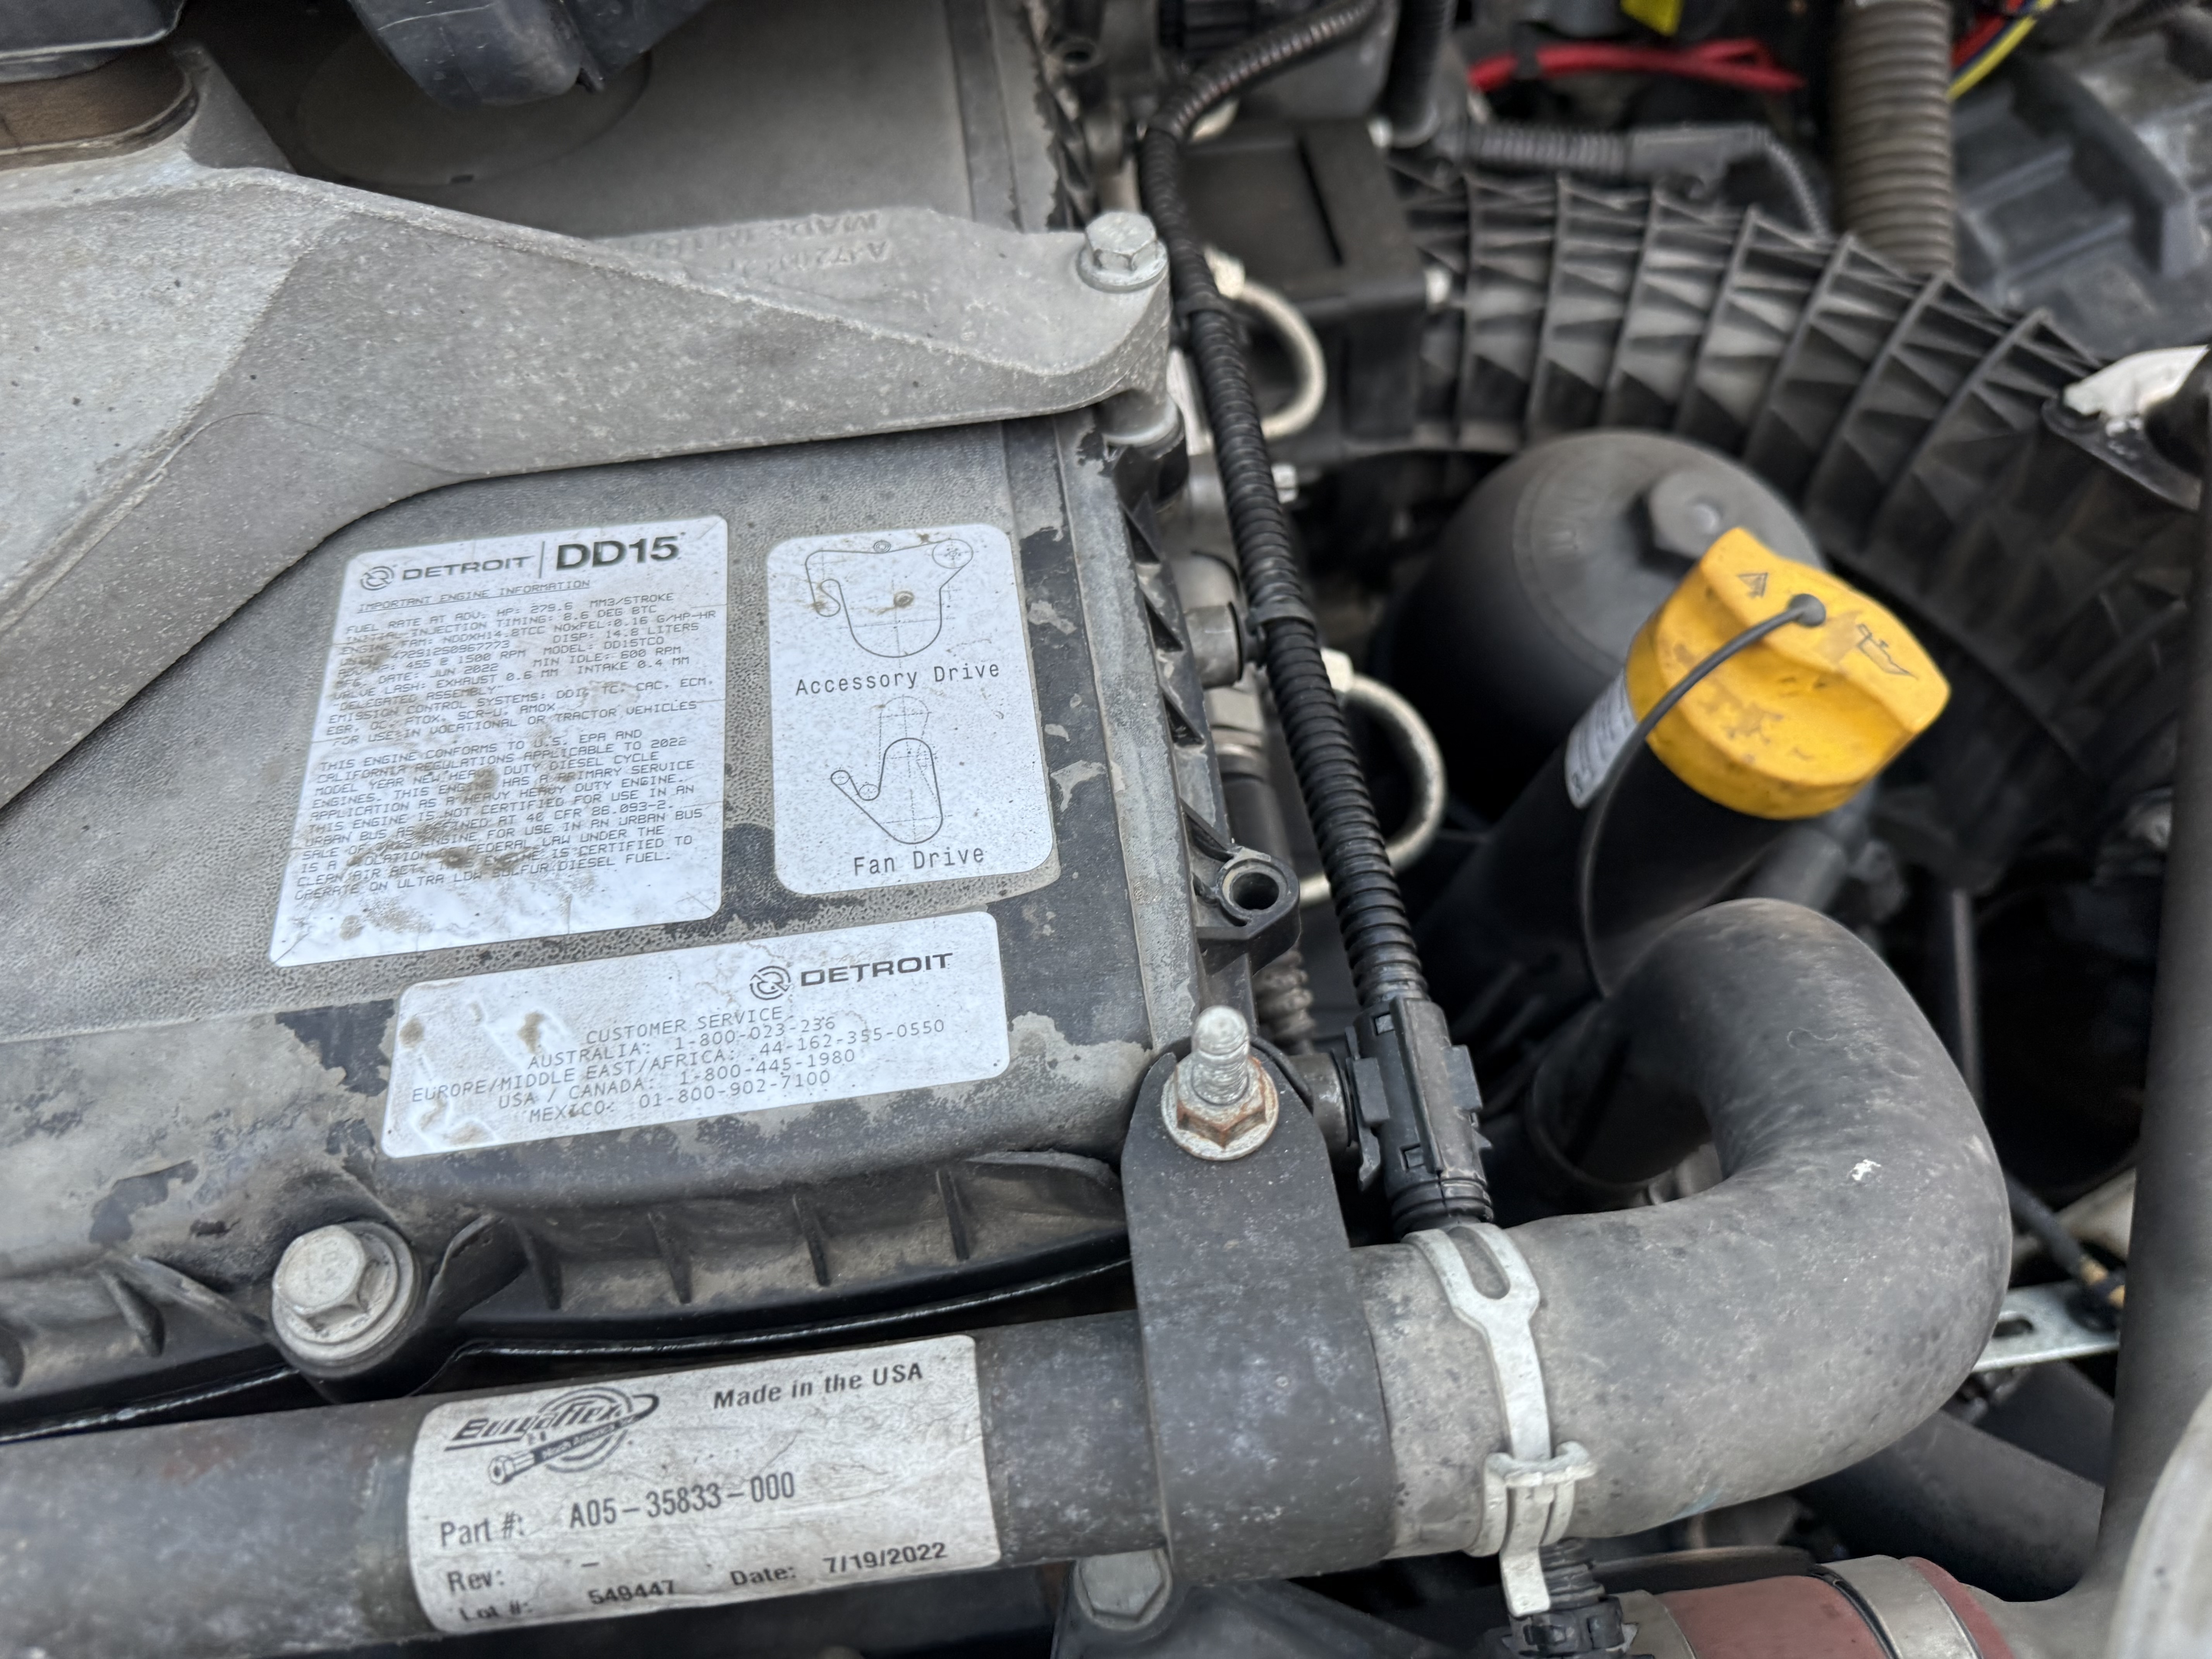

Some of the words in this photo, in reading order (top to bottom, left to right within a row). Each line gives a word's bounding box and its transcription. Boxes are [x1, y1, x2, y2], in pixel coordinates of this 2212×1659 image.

[402, 555, 535, 580] DETROIT
[556, 536, 679, 571] DD15
[345, 623, 380, 634] FUEL
[388, 618, 421, 629] RATE
[430, 615, 446, 624] AT
[589, 592, 674, 607] MM3/STROKE
[359, 596, 431, 611] IMPORTANT
[440, 590, 489, 602] ENGINE
[499, 579, 590, 596] INFORMATION
[497, 615, 553, 627] TIMING:
[563, 611, 589, 620] 8.6
[598, 608, 623, 617] DEG
[632, 605, 657, 614] BTC
[553, 632, 594, 643] DISP:
[606, 628, 639, 638] 14.8
[647, 622, 699, 634] LITERS
[384, 682, 426, 694] LASH:
[436, 675, 497, 688] EXHAUST
[506, 671, 532, 681] 0.6
[541, 668, 558, 677] MM
[578, 661, 628, 673] INTAKE
[637, 658, 663, 668] 0.4
[672, 656, 689, 665] MM
[405, 659, 431, 669] 455
[458, 653, 491, 663] 1500
[500, 649, 526, 659] RPM
[543, 642, 593, 654] MODEL:
[430, 668, 456, 678] JUN
[464, 663, 498, 674] 2022
[532, 657, 559, 667] MIN
[621, 649, 646, 658] 600
[656, 646, 681, 655] RPM
[795, 672, 917, 696] Accessory
[934, 663, 1000, 682] Drive
[404, 728, 421, 738] IN
[430, 718, 518, 735] VOCATIONAL
[527, 715, 545, 724] OR
[555, 708, 617, 721] TRACTOR
[626, 701, 697, 714] VEHICLES
[407, 700, 468, 714] CONTROL
[477, 692, 545, 706] SYSTEMS:
[520, 702, 555, 714] AMOX
[319, 759, 356, 771] THIS
[364, 752, 417, 766] ENGINE
[425, 744, 497, 759] CONFORMS
[507, 740, 525, 750] TO
[580, 732, 606, 742] EPA
[615, 728, 642, 739] AND
[415, 754, 514, 772] REGULATIONS
[524, 744, 614, 760] APPLICABLE
[624, 741, 641, 750] TO
[651, 737, 686, 748] 2022
[312, 792, 382, 808] ENGINES.
[393, 787, 429, 799] THIS
[502, 776, 530, 787] HAS
[539, 774, 548, 783] A
[631, 759, 694, 774] SERVICE
[315, 783, 359, 796] MODEL
[368, 777, 405, 789] YEAR
[413, 773, 440, 784] NEW
[504, 763, 541, 775] DUTY
[550, 756, 604, 769] DIESEL
[614, 751, 659, 763] CYCLE
[309, 802, 409, 821] APPLICATION
[418, 799, 436, 809] AS
[446, 797, 454, 805] A
[575, 780, 612, 792] DUTY
[622, 773, 683, 787] ENGINE.
[353, 814, 408, 828] ENGINE
[418, 811, 435, 821] IS
[444, 807, 471, 818] NOT
[481, 797, 564, 814] CERTIFIED
[573, 793, 601, 804] FOR
[611, 790, 639, 800] USE
[650, 787, 666, 797] IN
[676, 785, 694, 794] AN
[302, 847, 340, 860] SALE
[487, 828, 515, 839] FOR
[525, 824, 553, 835] USE
[564, 821, 580, 831] IN
[591, 818, 609, 828] AN
[619, 812, 665, 825] URBAN
[675, 809, 702, 820] BUS
[304, 833, 351, 847] URBAN
[359, 829, 387, 840] BUS
[498, 815, 517, 825] AT
[554, 808, 582, 819] CFR
[297, 872, 343, 886] CLEAN
[353, 868, 381, 880] AIR
[552, 848, 570, 858] IS
[579, 838, 663, 855] CERTIFIED
[675, 835, 692, 845] TO
[301, 862, 319, 873] IS
[328, 860, 337, 870] A
[467, 840, 527, 854] FEDERAL
[542, 835, 570, 846] LAW
[580, 829, 627, 842] UNDER
[637, 825, 664, 836] THE
[854, 857, 895, 876] Fan
[913, 847, 984, 870] Drive
[369, 881, 388, 891] ON
[397, 874, 444, 888] ULTRA
[454, 870, 483, 882] LOW
[558, 856, 616, 871] DIESEL
[626, 850, 671, 863] FUEL.
[801, 953, 953, 986] DETROIT
[527, 1042, 651, 1069] AUSTRALIA:
[675, 1016, 835, 1049] 1-800-023-236
[586, 1019, 687, 1044] CUSTOMER
[697, 1006, 782, 1029] SERVICE
[412, 1068, 575, 1102] EUROPE/MIDDLE
[586, 1049, 735, 1080] EAST/AFRICA:
[760, 1019, 944, 1055] 44-162-355-0550
[499, 1092, 536, 1109] USA
[547, 1089, 556, 1103] /
[568, 1077, 654, 1099] CANADA:
[680, 1049, 855, 1085] 1-800-445-1980
[639, 1070, 830, 1108] 01-800-902-7100
[714, 1384, 781, 1409] Made
[792, 1380, 812, 1398] in
[825, 1374, 862, 1393] the
[872, 1362, 923, 1386] USA
[441, 1518, 491, 1547] Part
[570, 1472, 795, 1528] A05-35833-000
[447, 1570, 504, 1594] Rev:
[730, 1566, 797, 1586] Date:
[823, 1542, 948, 1573] 7/19/2022
